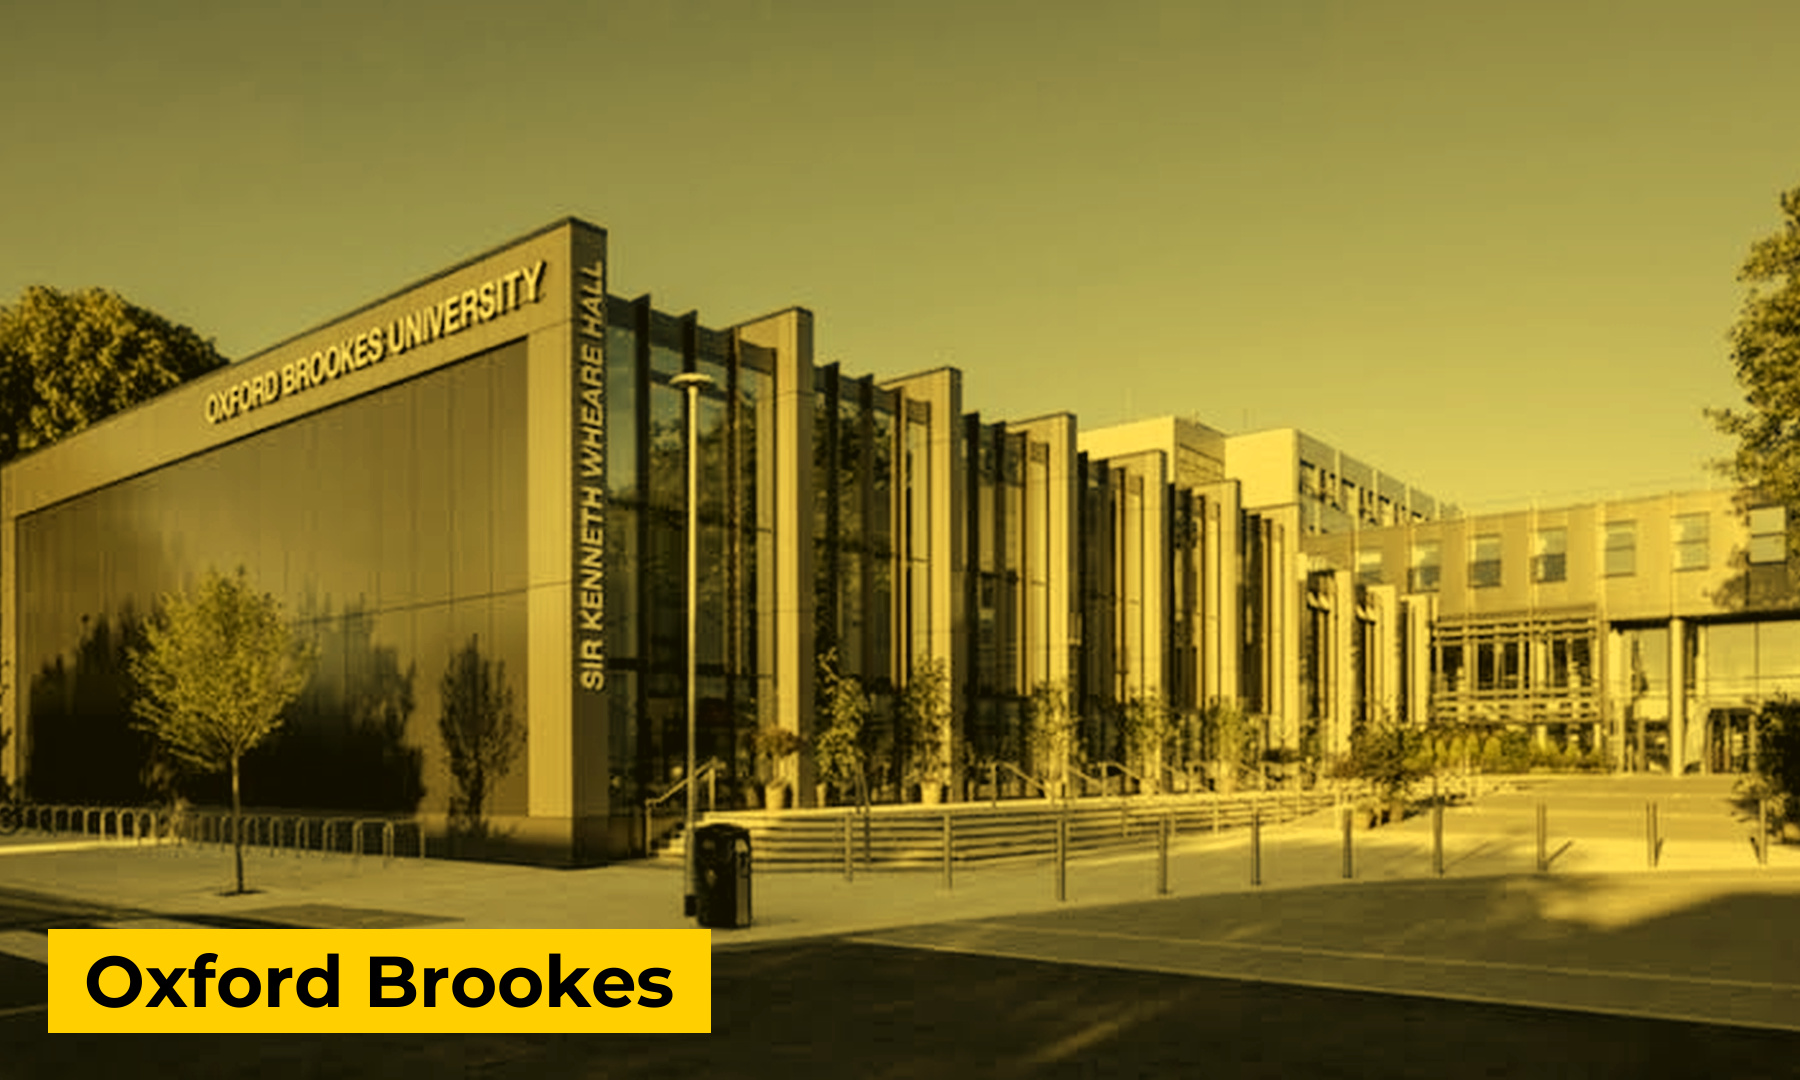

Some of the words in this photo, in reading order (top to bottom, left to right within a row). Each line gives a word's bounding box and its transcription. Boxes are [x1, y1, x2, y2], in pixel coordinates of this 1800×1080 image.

[204, 371, 279, 423] OXFORD
[281, 327, 386, 395] BROOKES
[388, 260, 547, 354] UNIVERSITY
[580, 261, 604, 335] HALL
[580, 344, 604, 479] WHEARE
[580, 485, 604, 631] KENNETH
[580, 639, 604, 691] SIR
